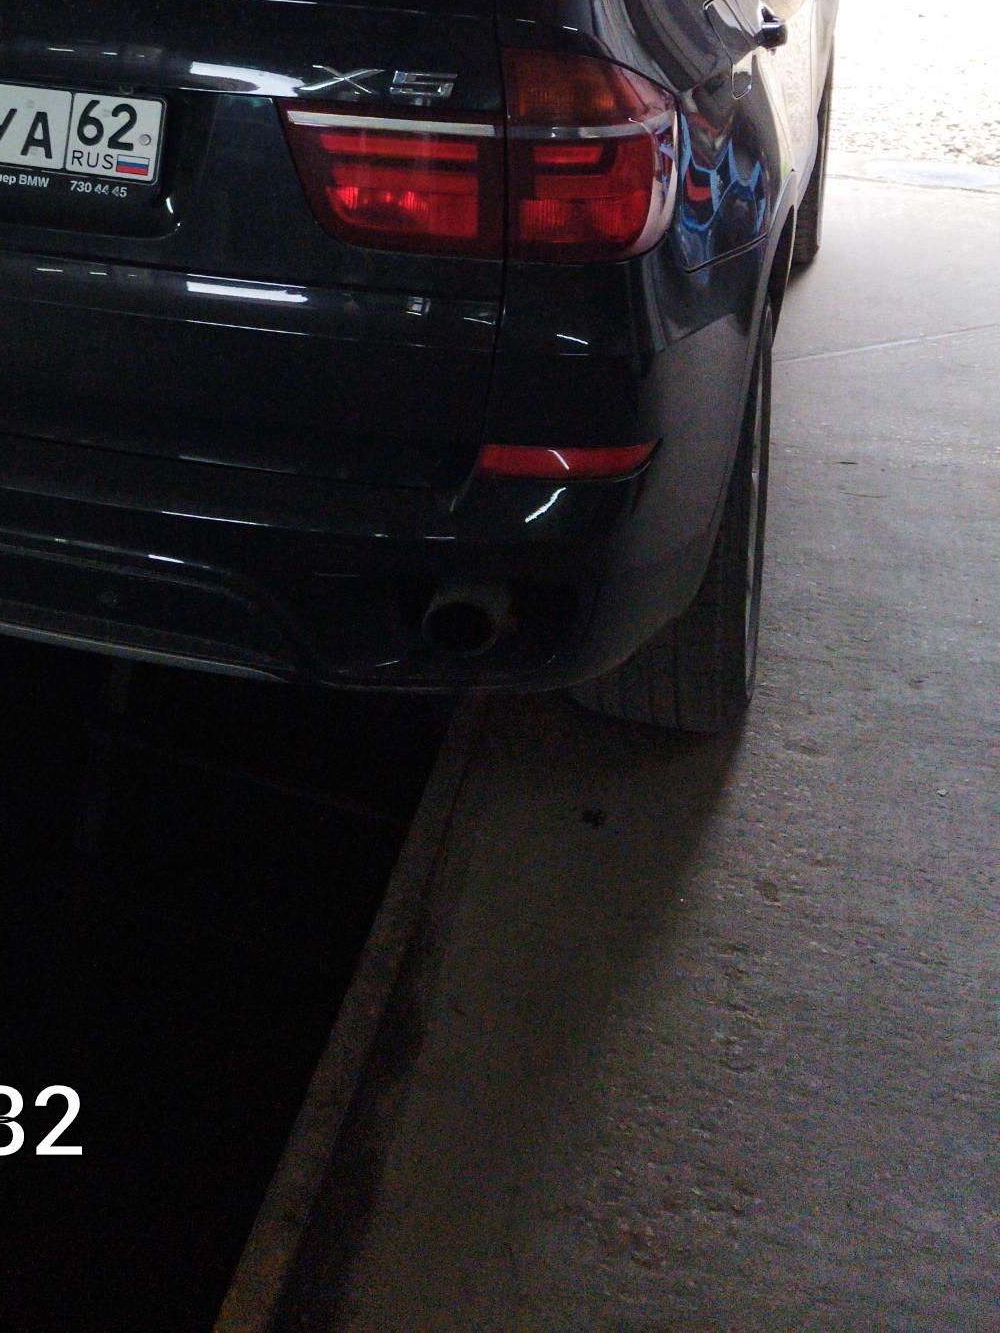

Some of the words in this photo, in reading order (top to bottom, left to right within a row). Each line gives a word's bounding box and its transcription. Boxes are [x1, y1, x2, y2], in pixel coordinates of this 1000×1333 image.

[299, 64, 458, 99] X5
[76, 99, 138, 152] 62
[71, 149, 115, 170] RUS
[18, 174, 50, 188] BMW
[70, 180, 92, 193] 730
